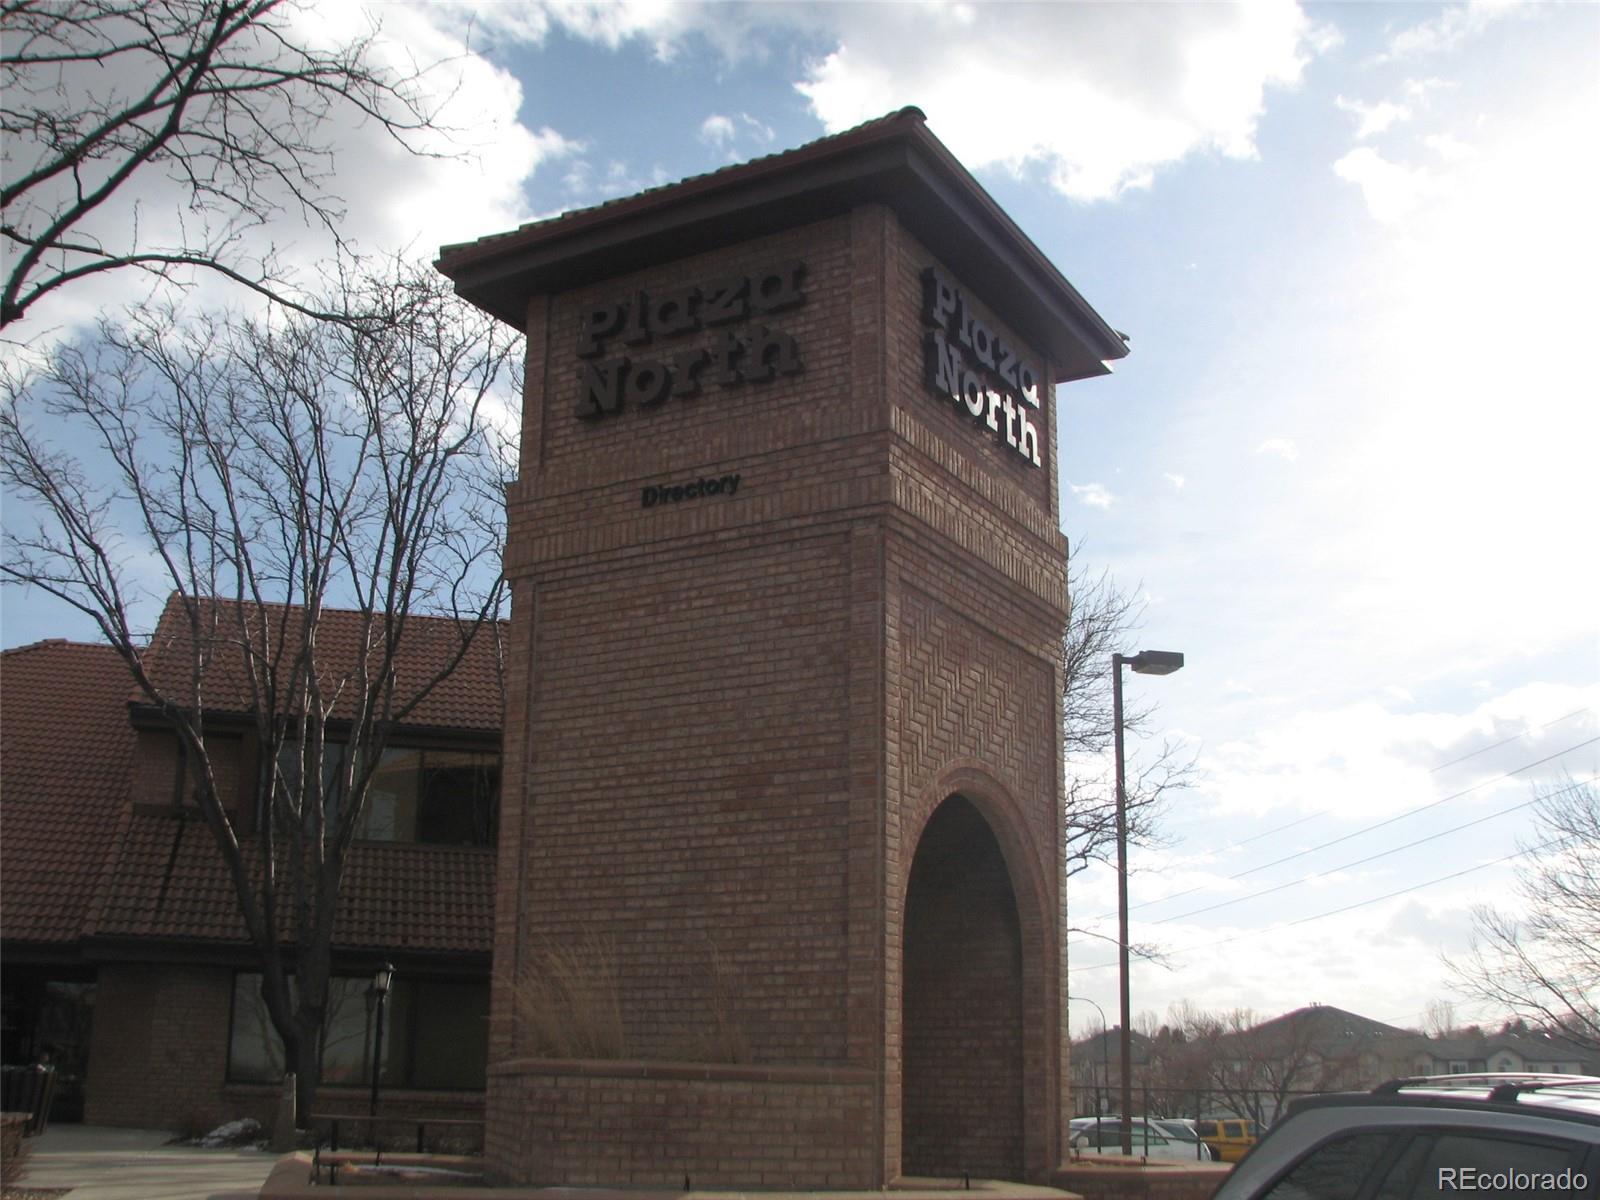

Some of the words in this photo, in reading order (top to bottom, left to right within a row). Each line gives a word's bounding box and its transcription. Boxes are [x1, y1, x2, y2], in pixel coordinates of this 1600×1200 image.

[577, 262, 806, 358] Plaza
[925, 267, 1040, 409] Plaza
[576, 326, 804, 419] North
[930, 331, 1041, 467] North
[642, 474, 740, 508] Directory
